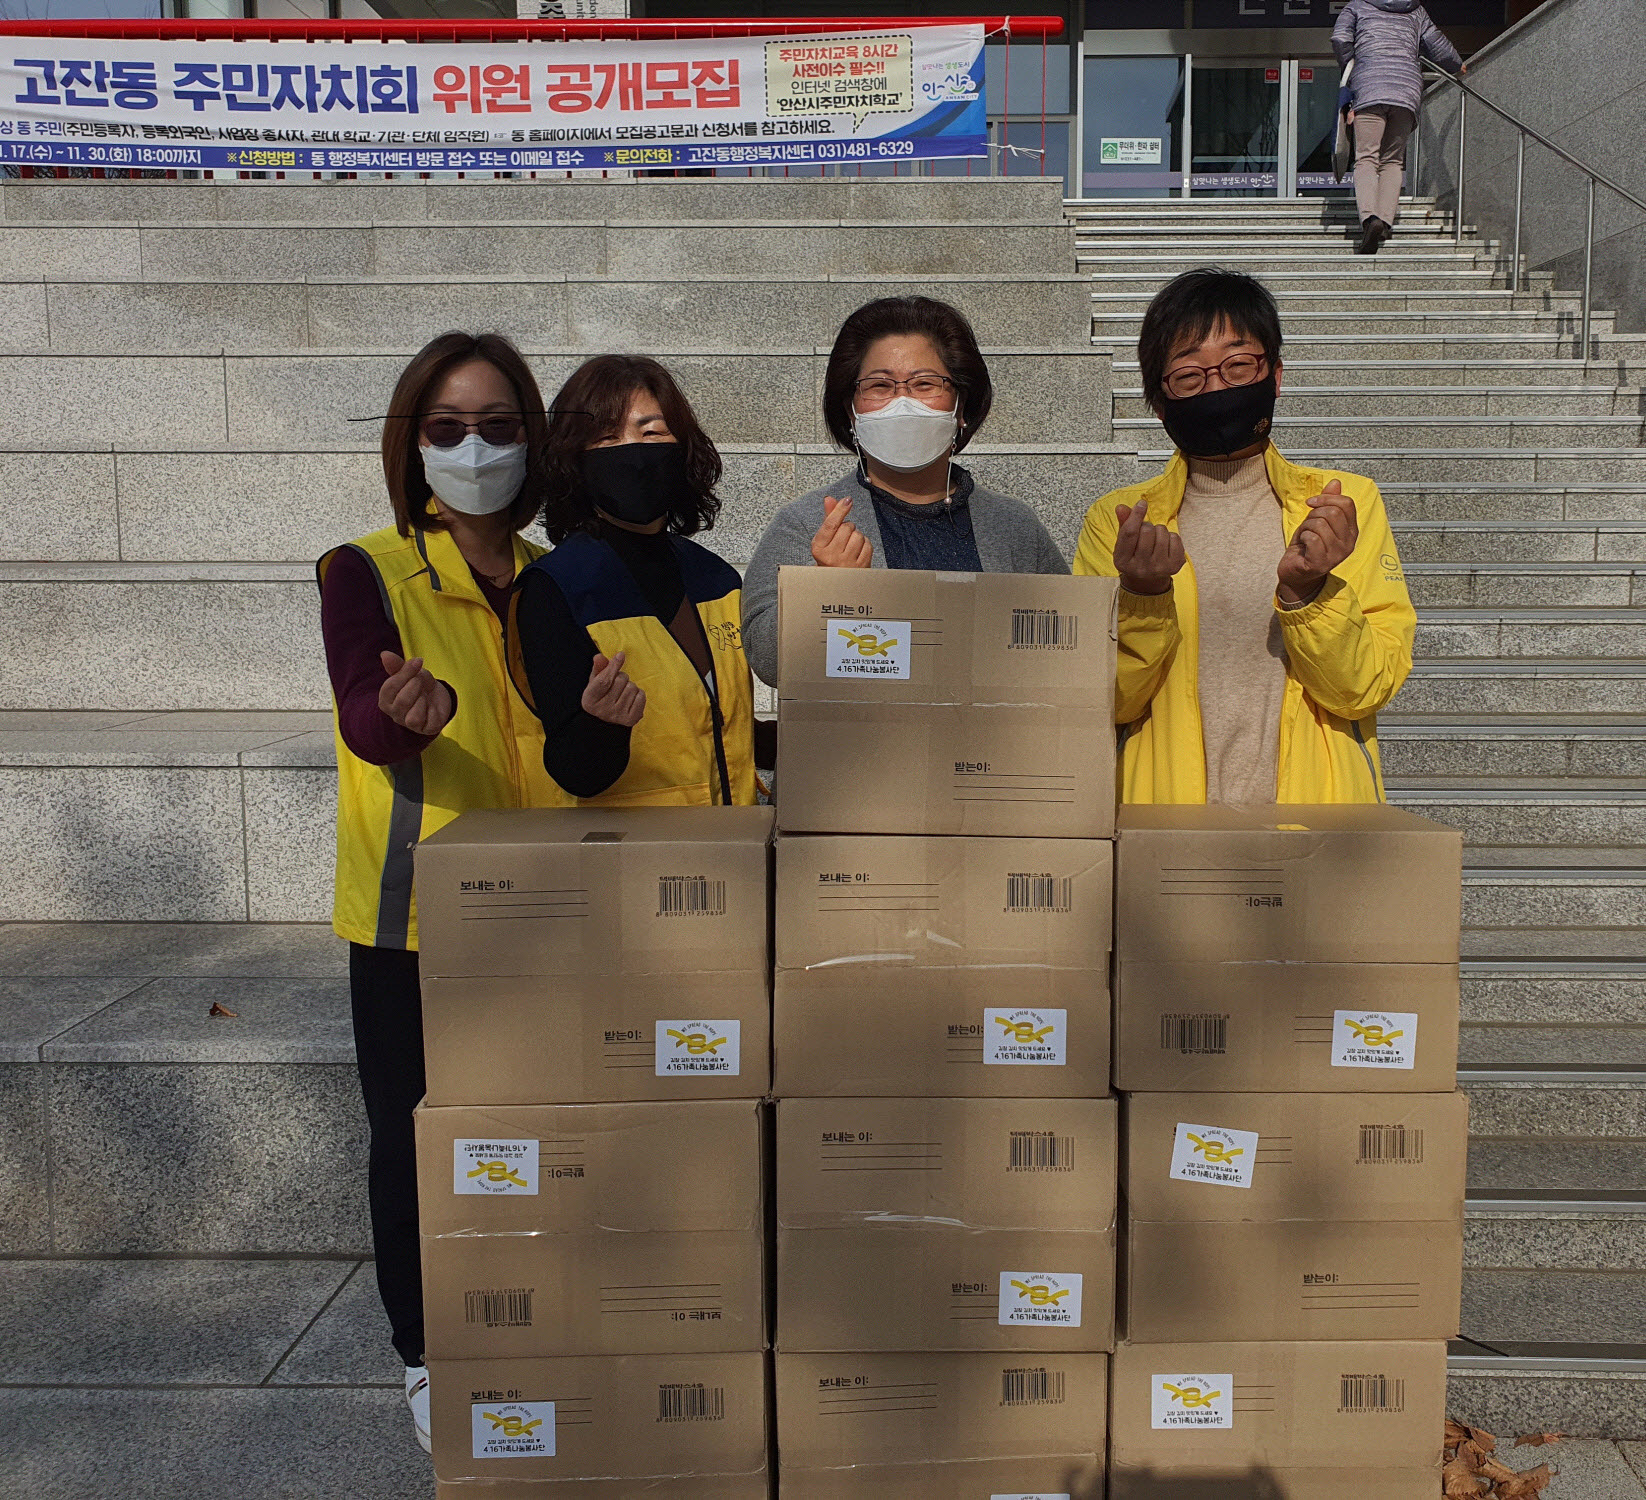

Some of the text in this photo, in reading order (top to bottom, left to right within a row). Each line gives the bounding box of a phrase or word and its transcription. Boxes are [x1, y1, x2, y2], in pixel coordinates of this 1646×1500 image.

[779, 44, 898, 62] 주민자치교육 8시간
[793, 61, 885, 78] 사전이수 필수!!
[13, 58, 742, 114] 고잔동 주민자치회 위원 공개모집
[791, 77, 887, 95] 인터넷 검색창에
[17, 121, 31, 135] 동
[35, 122, 138, 139] 주민(주민등록자,
[143, 124, 214, 141] 등록외국인,
[219, 127, 258, 141] 사업장
[262, 128, 309, 142] 종사자,
[311, 130, 339, 143] 관내
[444, 130, 489, 143] 임직원)
[511, 129, 524, 142] 동
[529, 127, 612, 142] 홈페이지에서
[616, 123, 698, 140] 모집공고문과
[702, 121, 757, 138] 신청서를
[761, 119, 835, 135] 참고하세요.
[11, 144, 52, 159] 17.(수)
[67, 146, 85, 161] 11.
[88, 146, 132, 162] 30.(화)
[136, 148, 201, 164] 18:00까지
[311, 152, 325, 166] 동
[328, 152, 412, 167] 행정복지센터
[416, 152, 444, 167] 방문
[448, 152, 476, 166] 접수
[479, 151, 507, 166] 또는
[510, 150, 552, 166] 이메일
[556, 150, 584, 165] 접수
[688, 144, 814, 163] 고잔동행정복지센터
[818, 141, 913, 159] 031)481-6329
[1192, 177, 1219, 185] 살맛나는
[1220, 177, 1247, 185] 생생도시
[1299, 176, 1325, 184] 살맛나는
[820, 604, 873, 616] 보내는 이:
[954, 761, 991, 772] 받는이:
[818, 872, 870, 882] 보내는 이:
[460, 880, 514, 891] 보내는 이:
[1245, 896, 1283, 907] 받는이:
[604, 1030, 642, 1040] 받는이:
[948, 1024, 984, 1035] 받는이:
[822, 1131, 873, 1142] 보내는 이:
[548, 1168, 584, 1178] 받는이:
[1303, 1273, 1339, 1283] 받는이:
[951, 1282, 988, 1293] 받는이:
[671, 1311, 721, 1320] 보내는 이:
[818, 1375, 869, 1388] 보내는 이:
[470, 1390, 522, 1400] 보내는 이:
